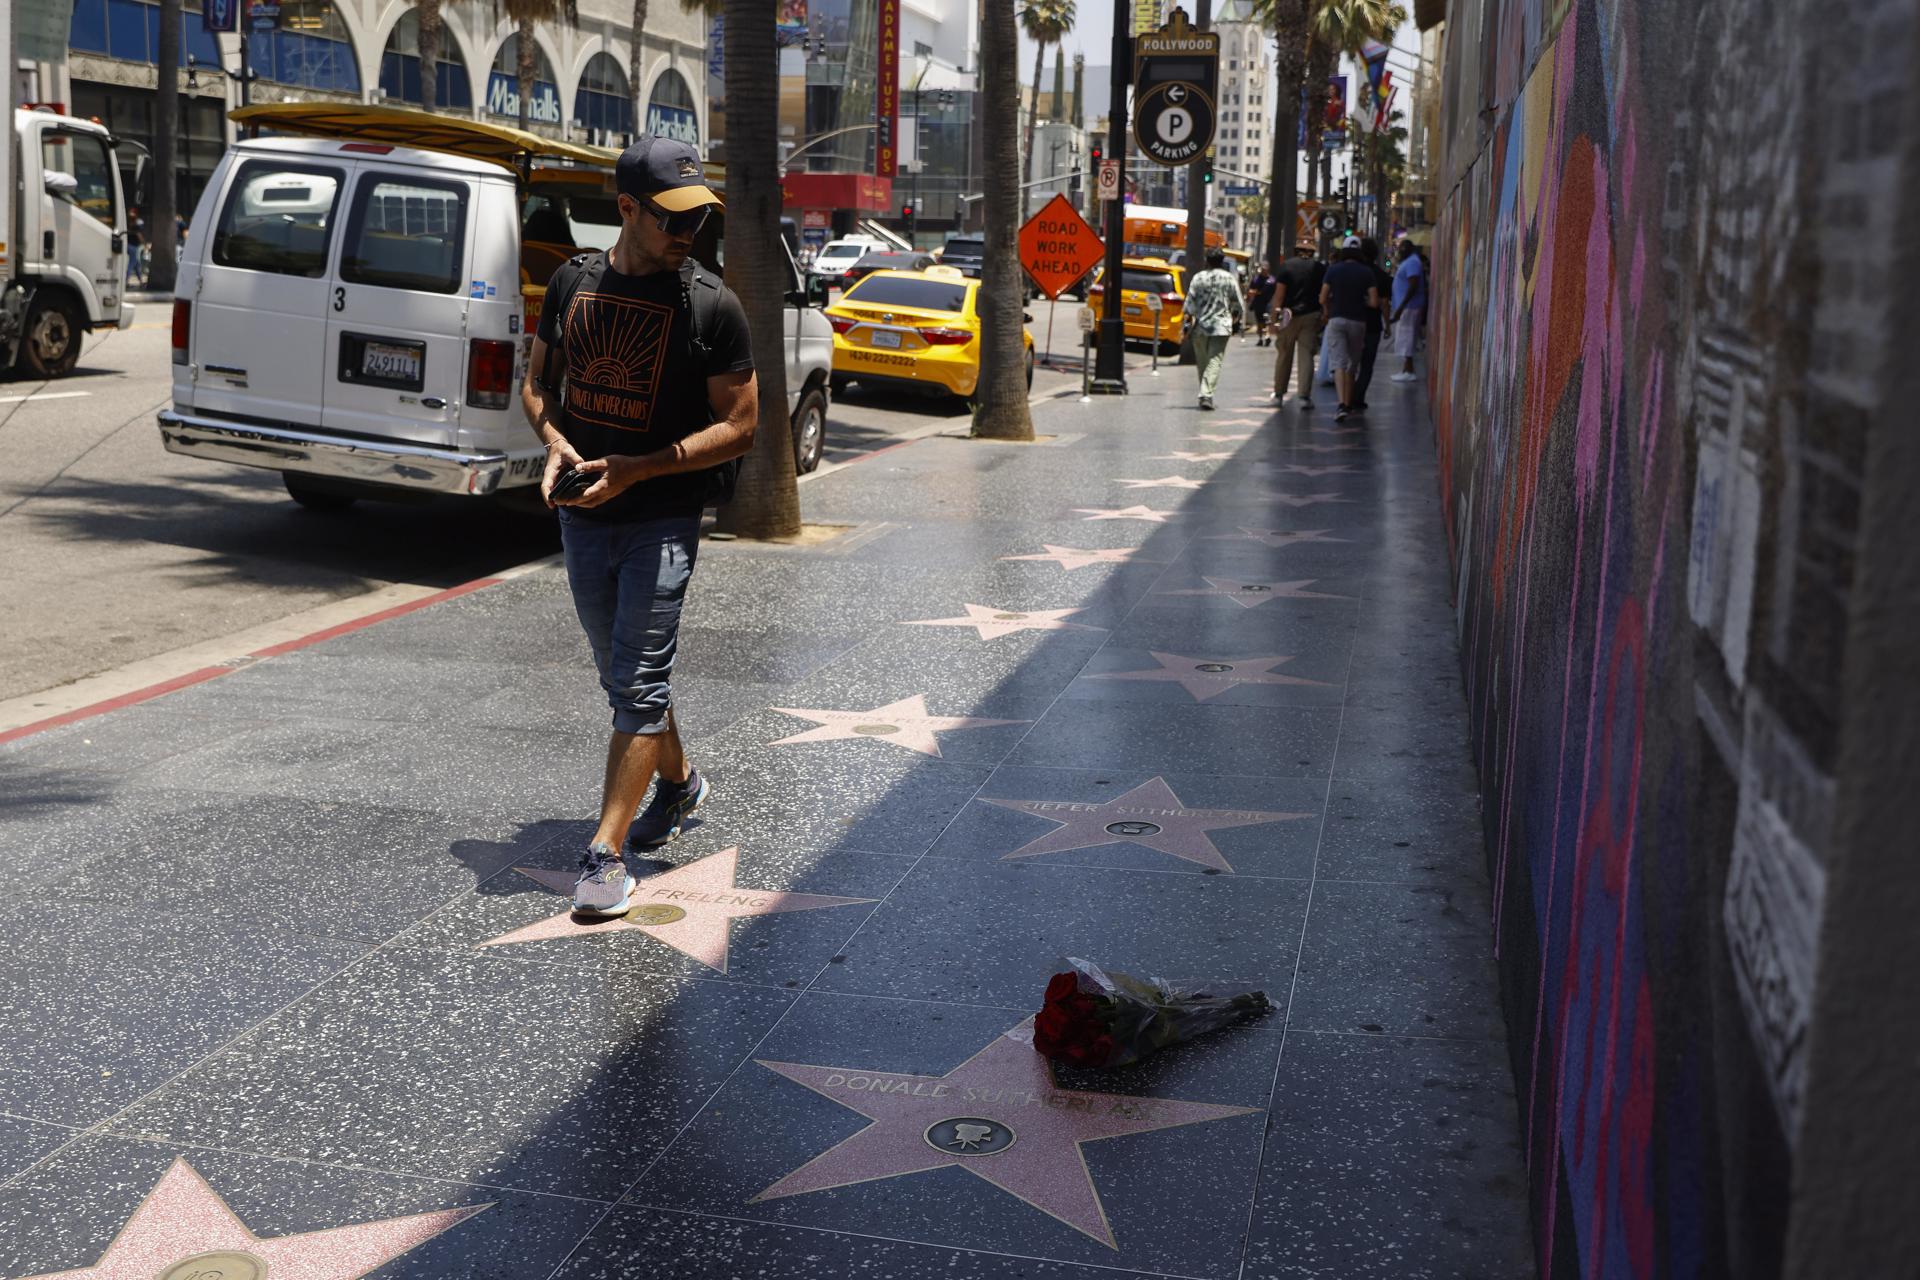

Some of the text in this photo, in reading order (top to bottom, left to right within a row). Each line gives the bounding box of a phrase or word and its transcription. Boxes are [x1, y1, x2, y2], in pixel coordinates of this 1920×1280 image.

[1144, 39, 1213, 50] HOLLYWOOD
[488, 78, 560, 122] Marhalls
[648, 107, 697, 142] Marshalls
[1169, 114, 1183, 137] P
[1151, 141, 1197, 158] PARKING
[1038, 221, 1078, 235] ROAD
[1037, 241, 1077, 254] WORK
[1031, 260, 1080, 275] AHEAD
[333, 287, 345, 312] 3
[593, 392, 620, 416] NEVER
[621, 398, 649, 420] ENDS
[652, 889, 766, 907] FRELENG
[824, 1073, 950, 1098] DONALD
